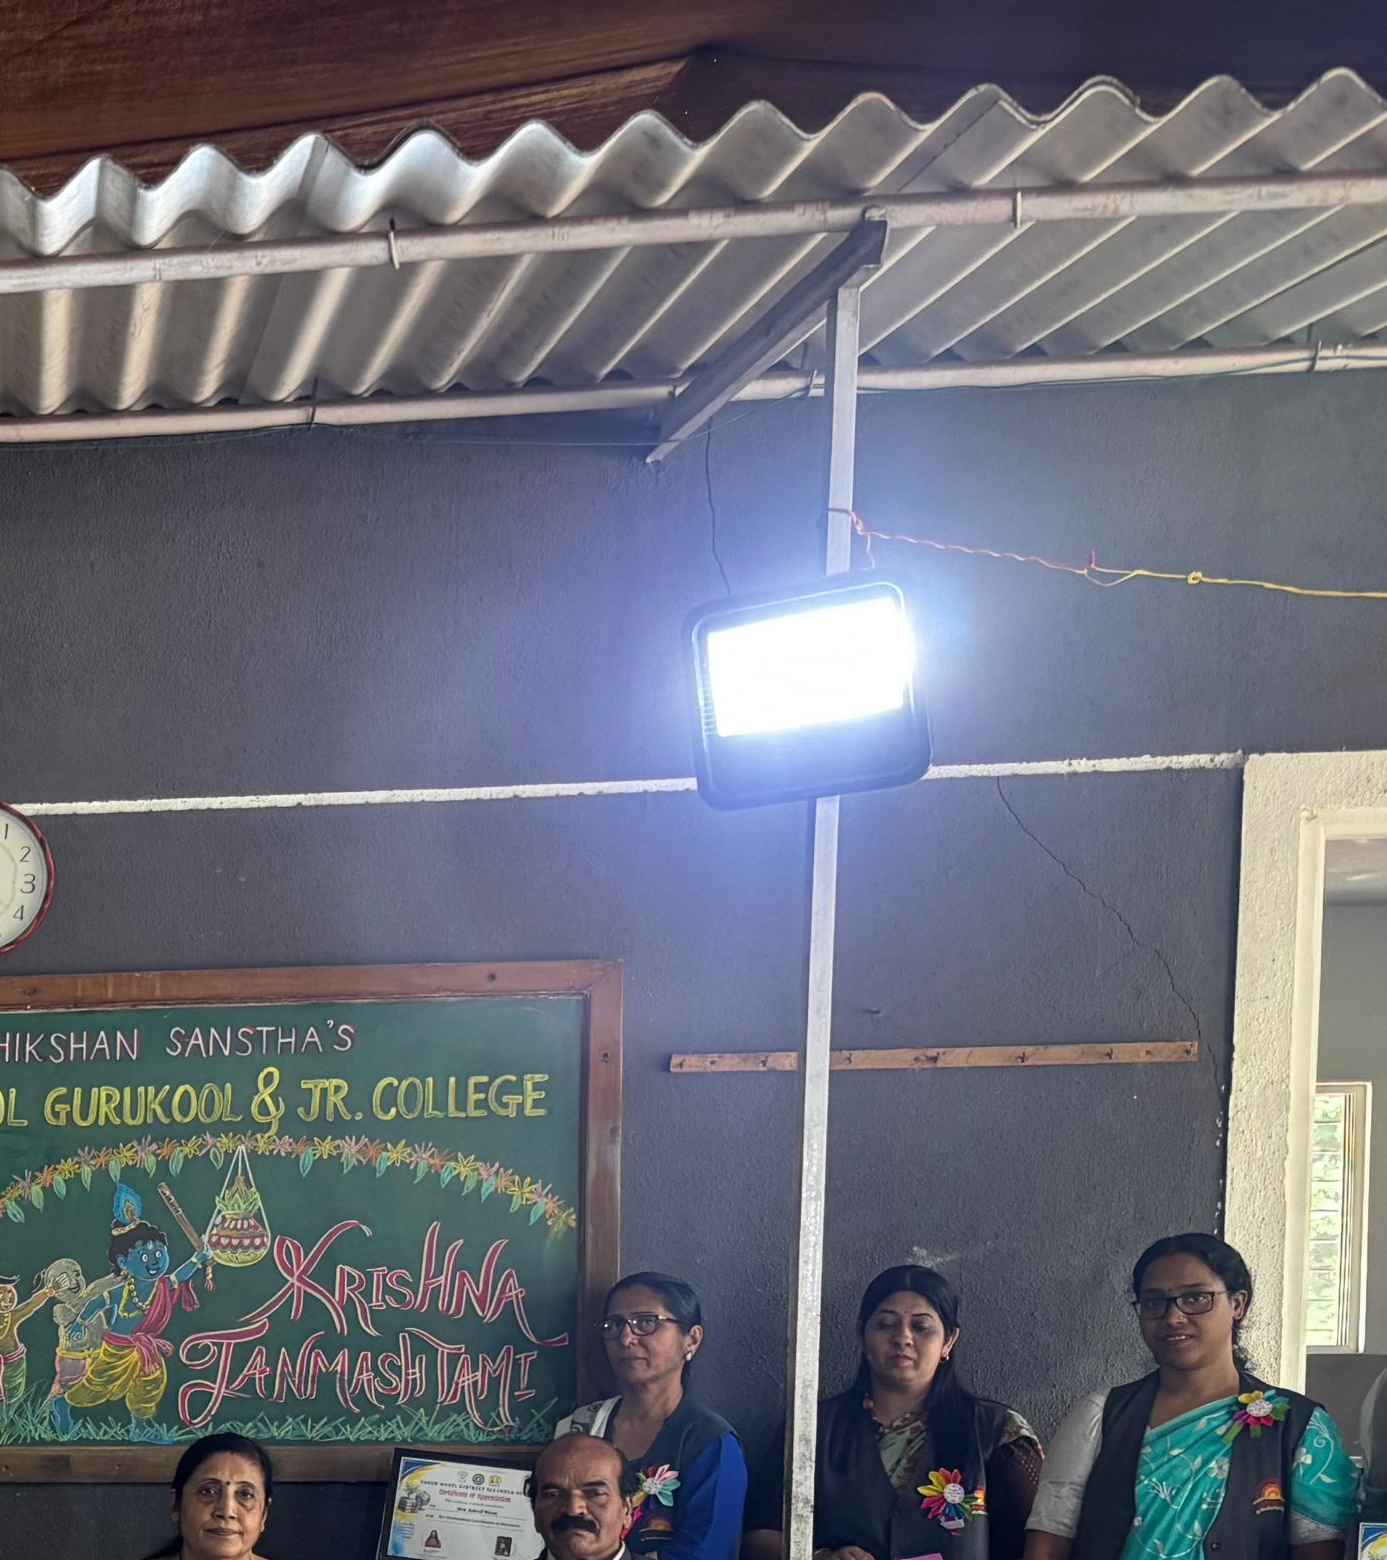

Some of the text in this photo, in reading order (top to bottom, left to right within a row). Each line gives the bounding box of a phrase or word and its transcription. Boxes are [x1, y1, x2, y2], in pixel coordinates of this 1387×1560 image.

[4, 824, 9, 839] 1
[20, 846, 31, 862] 2
[20, 874, 36, 894] 3
[13, 905, 24, 921] 4
[166, 1019, 355, 1057] SANSTHA'S
[44, 1082, 242, 1126] GURUKOOL
[251, 1066, 285, 1136] &
[297, 1078, 363, 1122] JR.
[372, 1073, 549, 1119] COLLEGE
